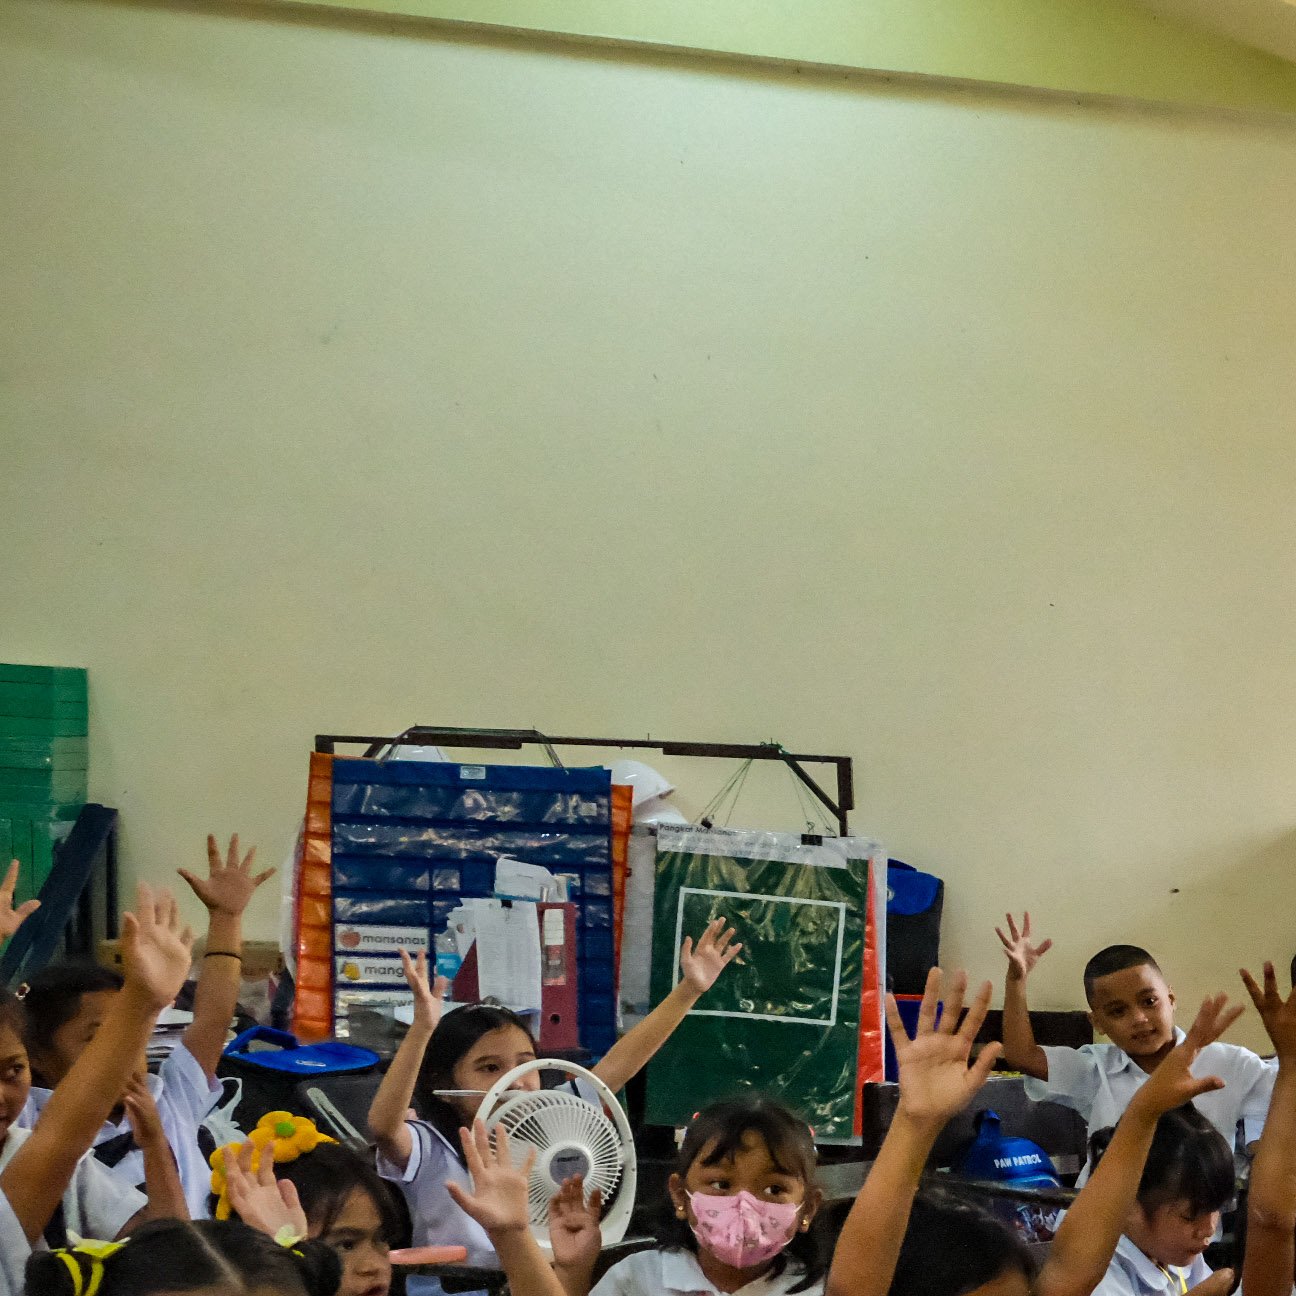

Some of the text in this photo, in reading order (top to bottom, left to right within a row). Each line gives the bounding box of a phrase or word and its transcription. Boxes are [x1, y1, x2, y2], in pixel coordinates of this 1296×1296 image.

[362, 934, 426, 945] mansanas
[364, 965, 405, 977] mang
[993, 1154, 1042, 1168] PAW PATROL
